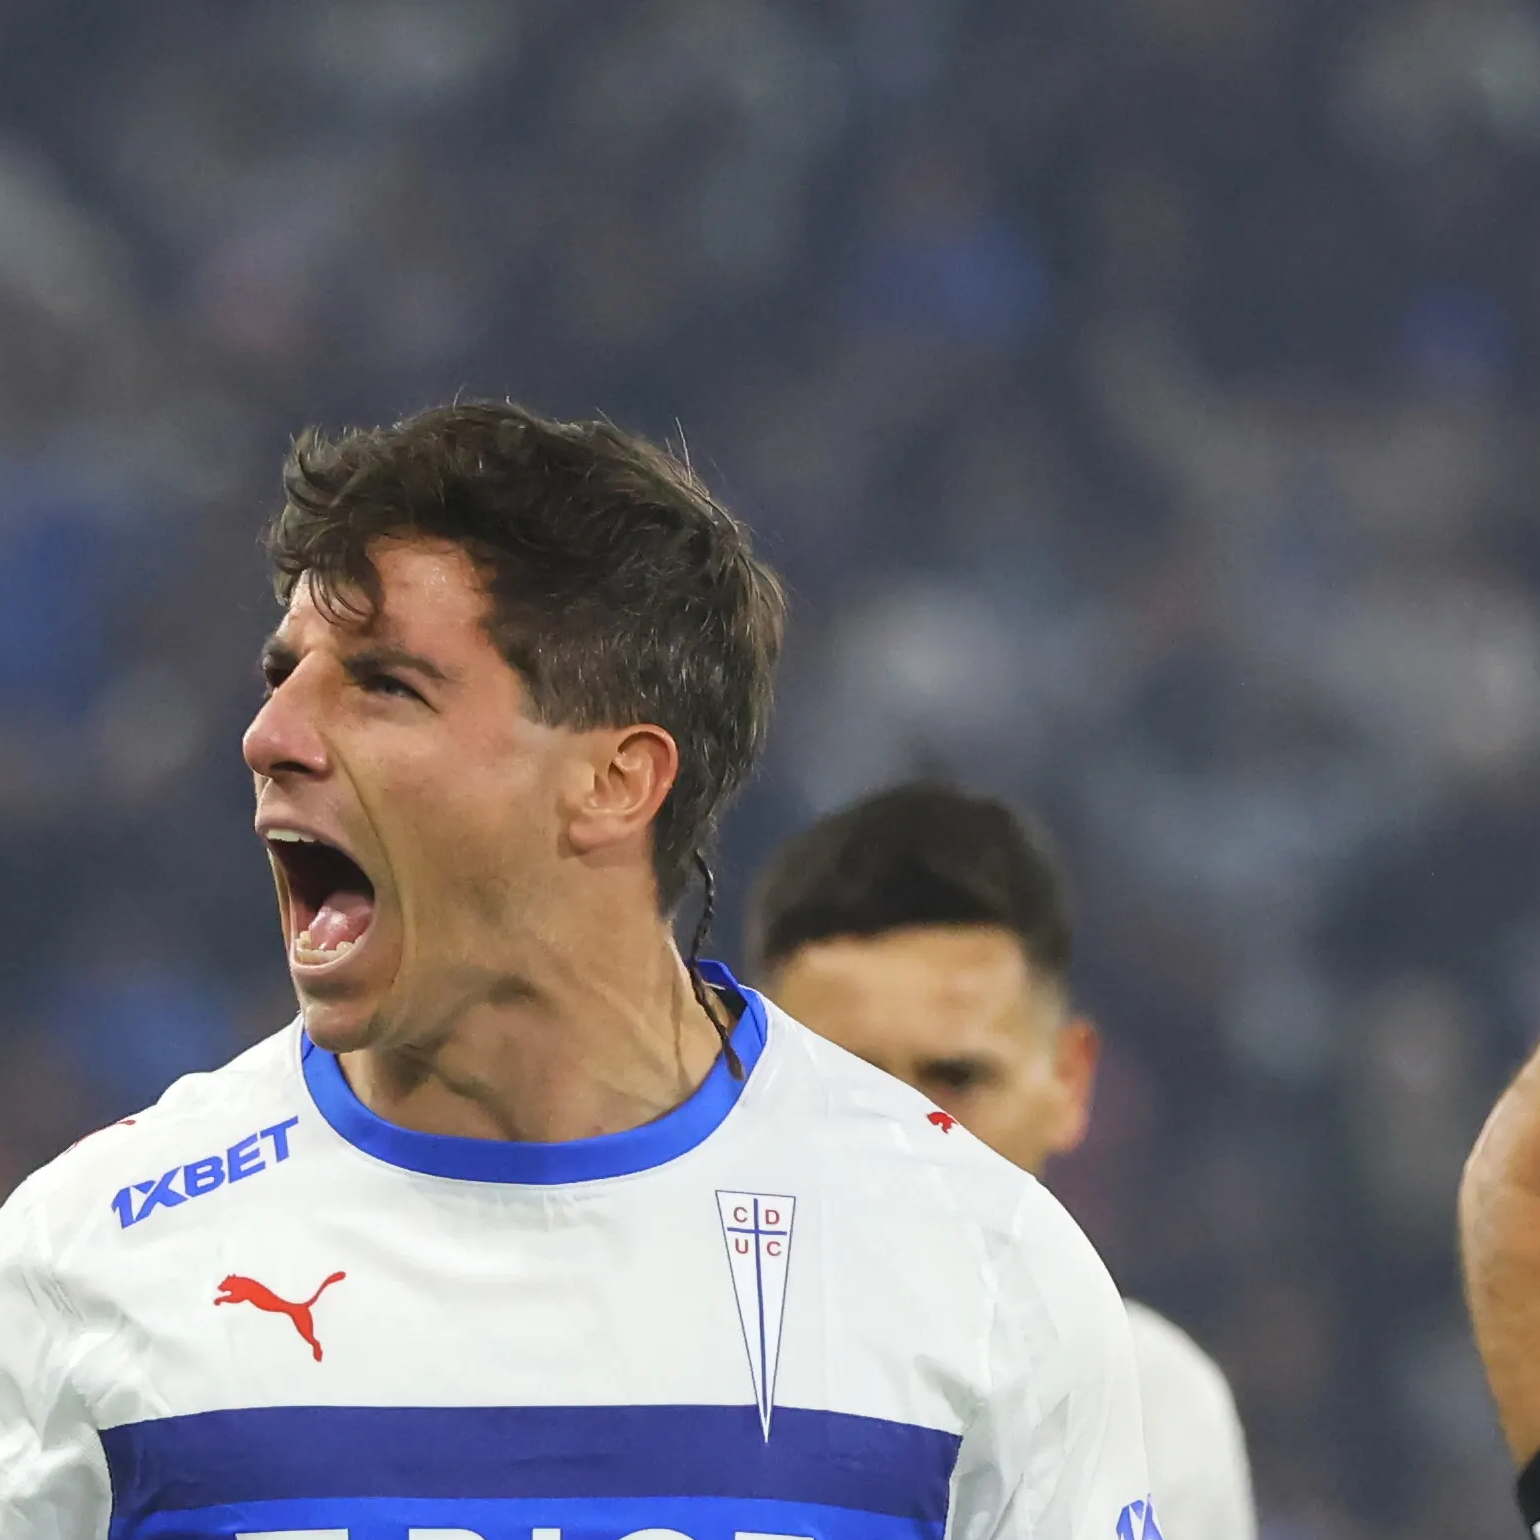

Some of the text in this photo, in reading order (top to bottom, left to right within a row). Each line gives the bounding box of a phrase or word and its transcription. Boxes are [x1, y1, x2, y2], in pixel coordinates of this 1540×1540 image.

[111, 1115, 299, 1229] 1XBET
[733, 1206, 780, 1225] C D
[735, 1238, 782, 1257] U C
